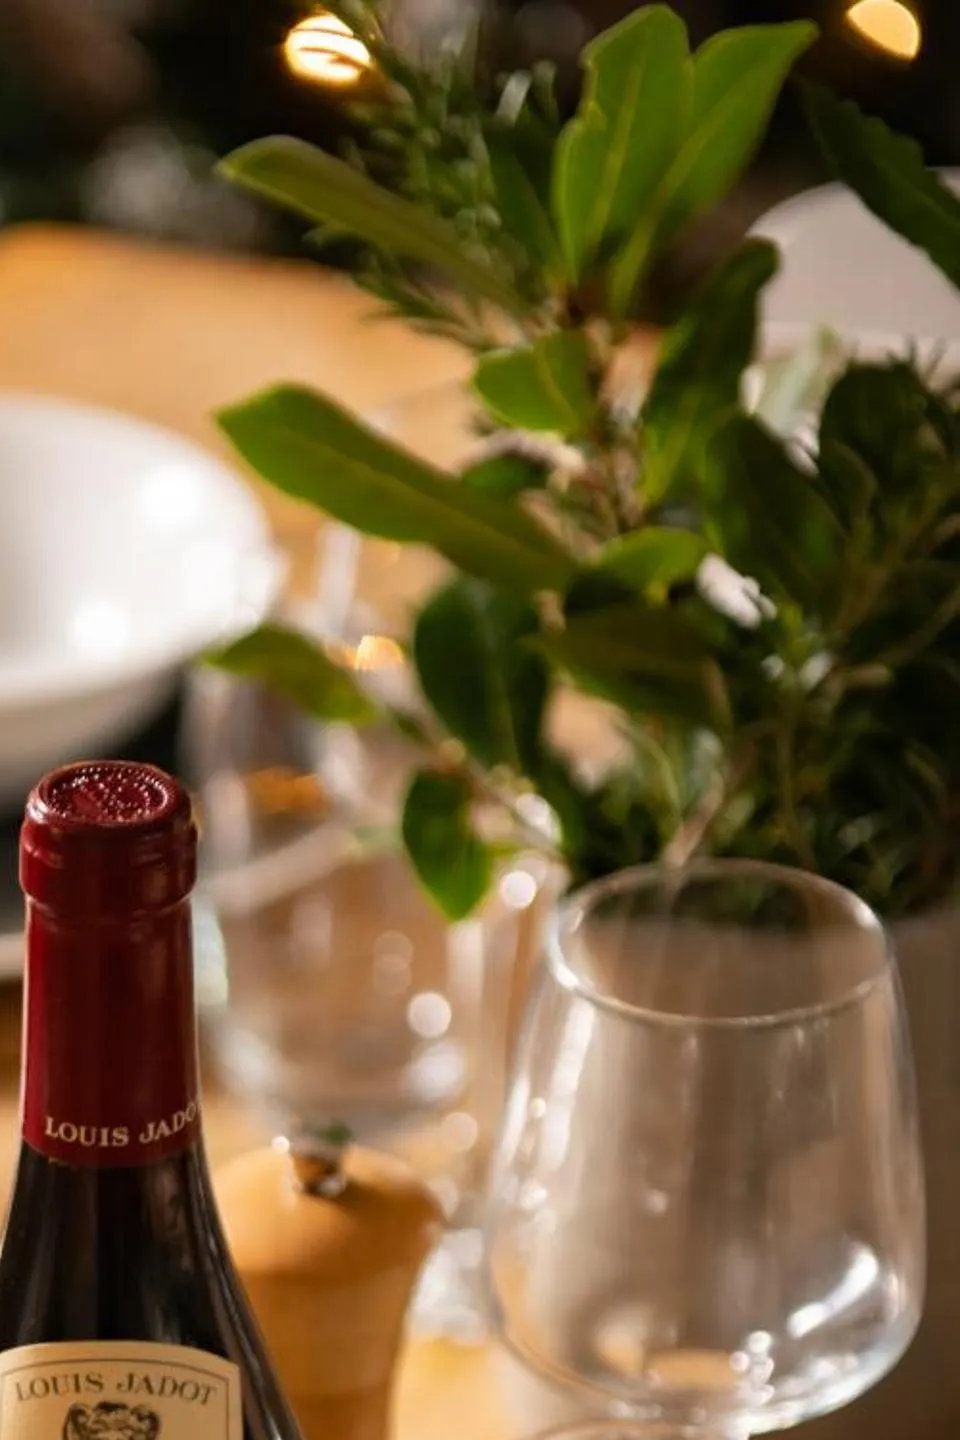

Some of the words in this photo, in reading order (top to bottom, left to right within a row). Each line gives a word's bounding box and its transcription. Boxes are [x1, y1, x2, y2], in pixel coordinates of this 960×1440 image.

[43, 1115, 130, 1148] LOUIS
[138, 1100, 198, 1145] JADO
[15, 1371, 104, 1402] LOUIS
[116, 1372, 218, 1406] JADOT
